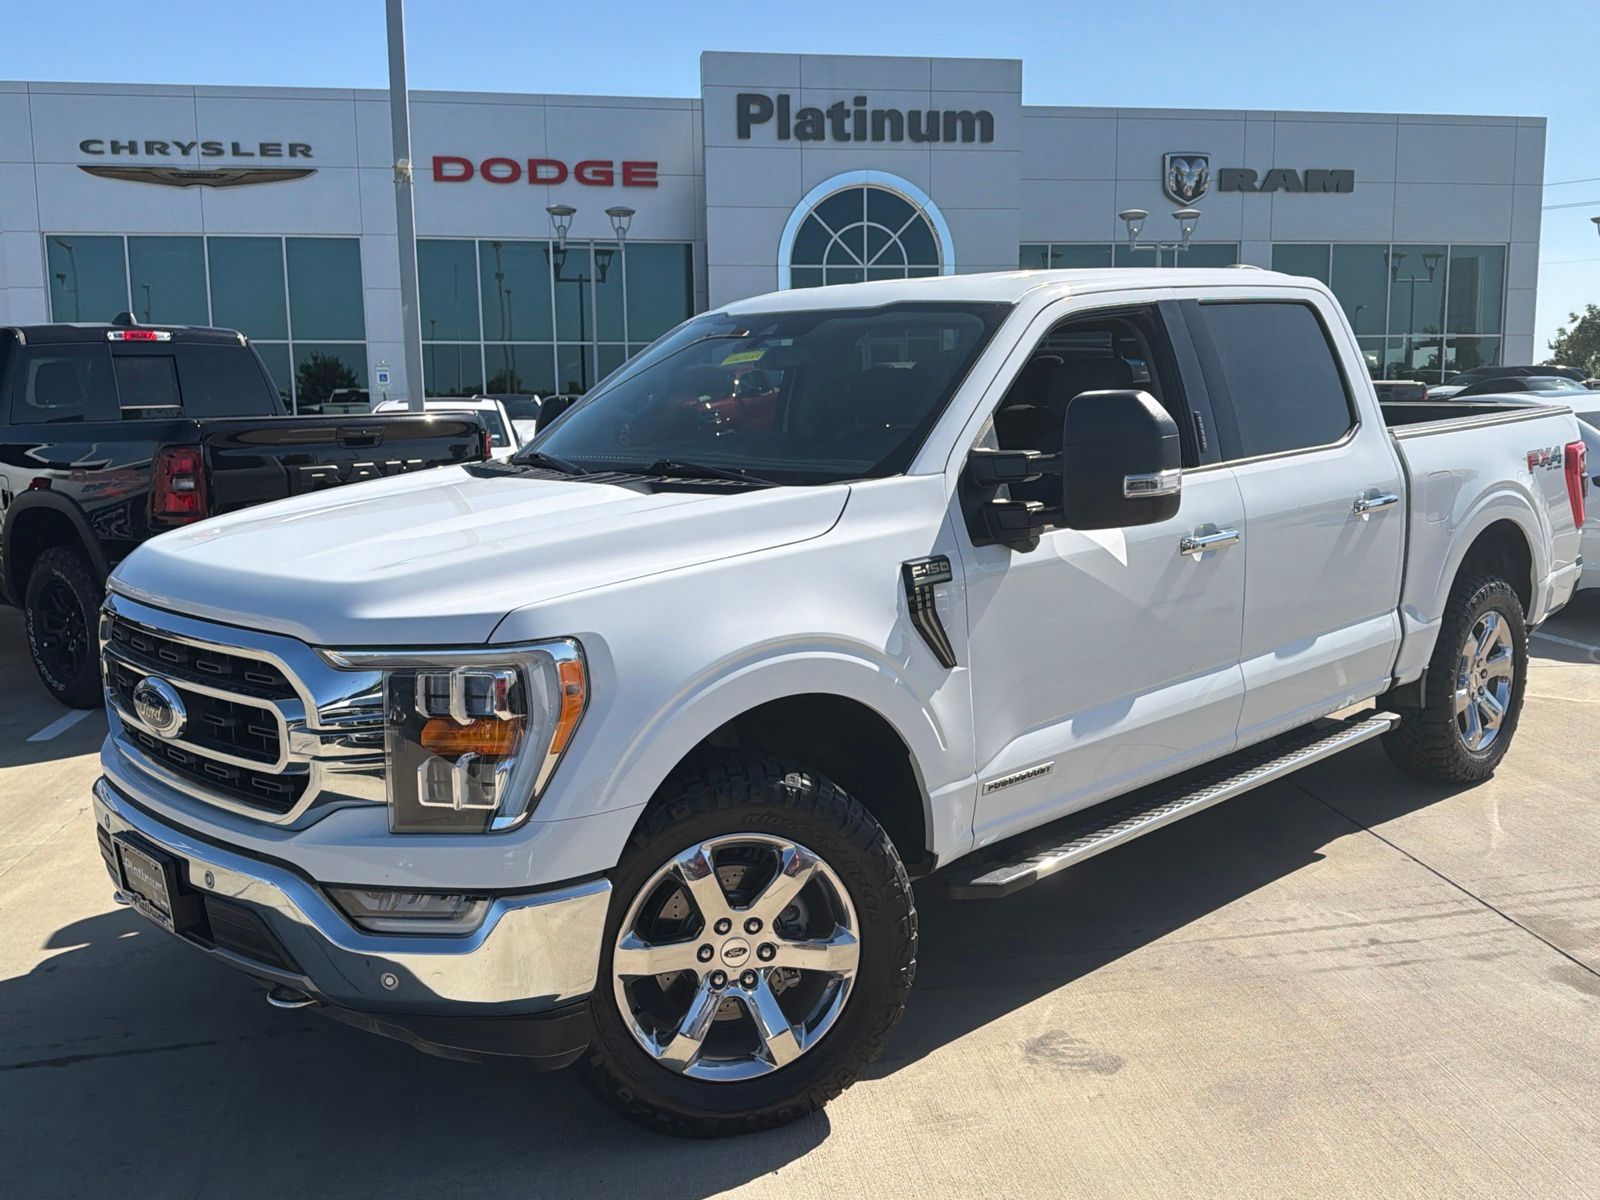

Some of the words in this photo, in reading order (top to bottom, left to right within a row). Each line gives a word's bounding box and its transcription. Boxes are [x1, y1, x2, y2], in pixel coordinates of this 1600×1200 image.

[736, 93, 994, 142] Platinum
[79, 139, 313, 158] CHRYSLER
[432, 156, 658, 187] DODGE
[1219, 168, 1354, 193] RAM
[1527, 446, 1562, 475] FX4
[912, 561, 950, 578] F-150
[139, 692, 163, 722] Ford
[727, 947, 745, 957] Ford
